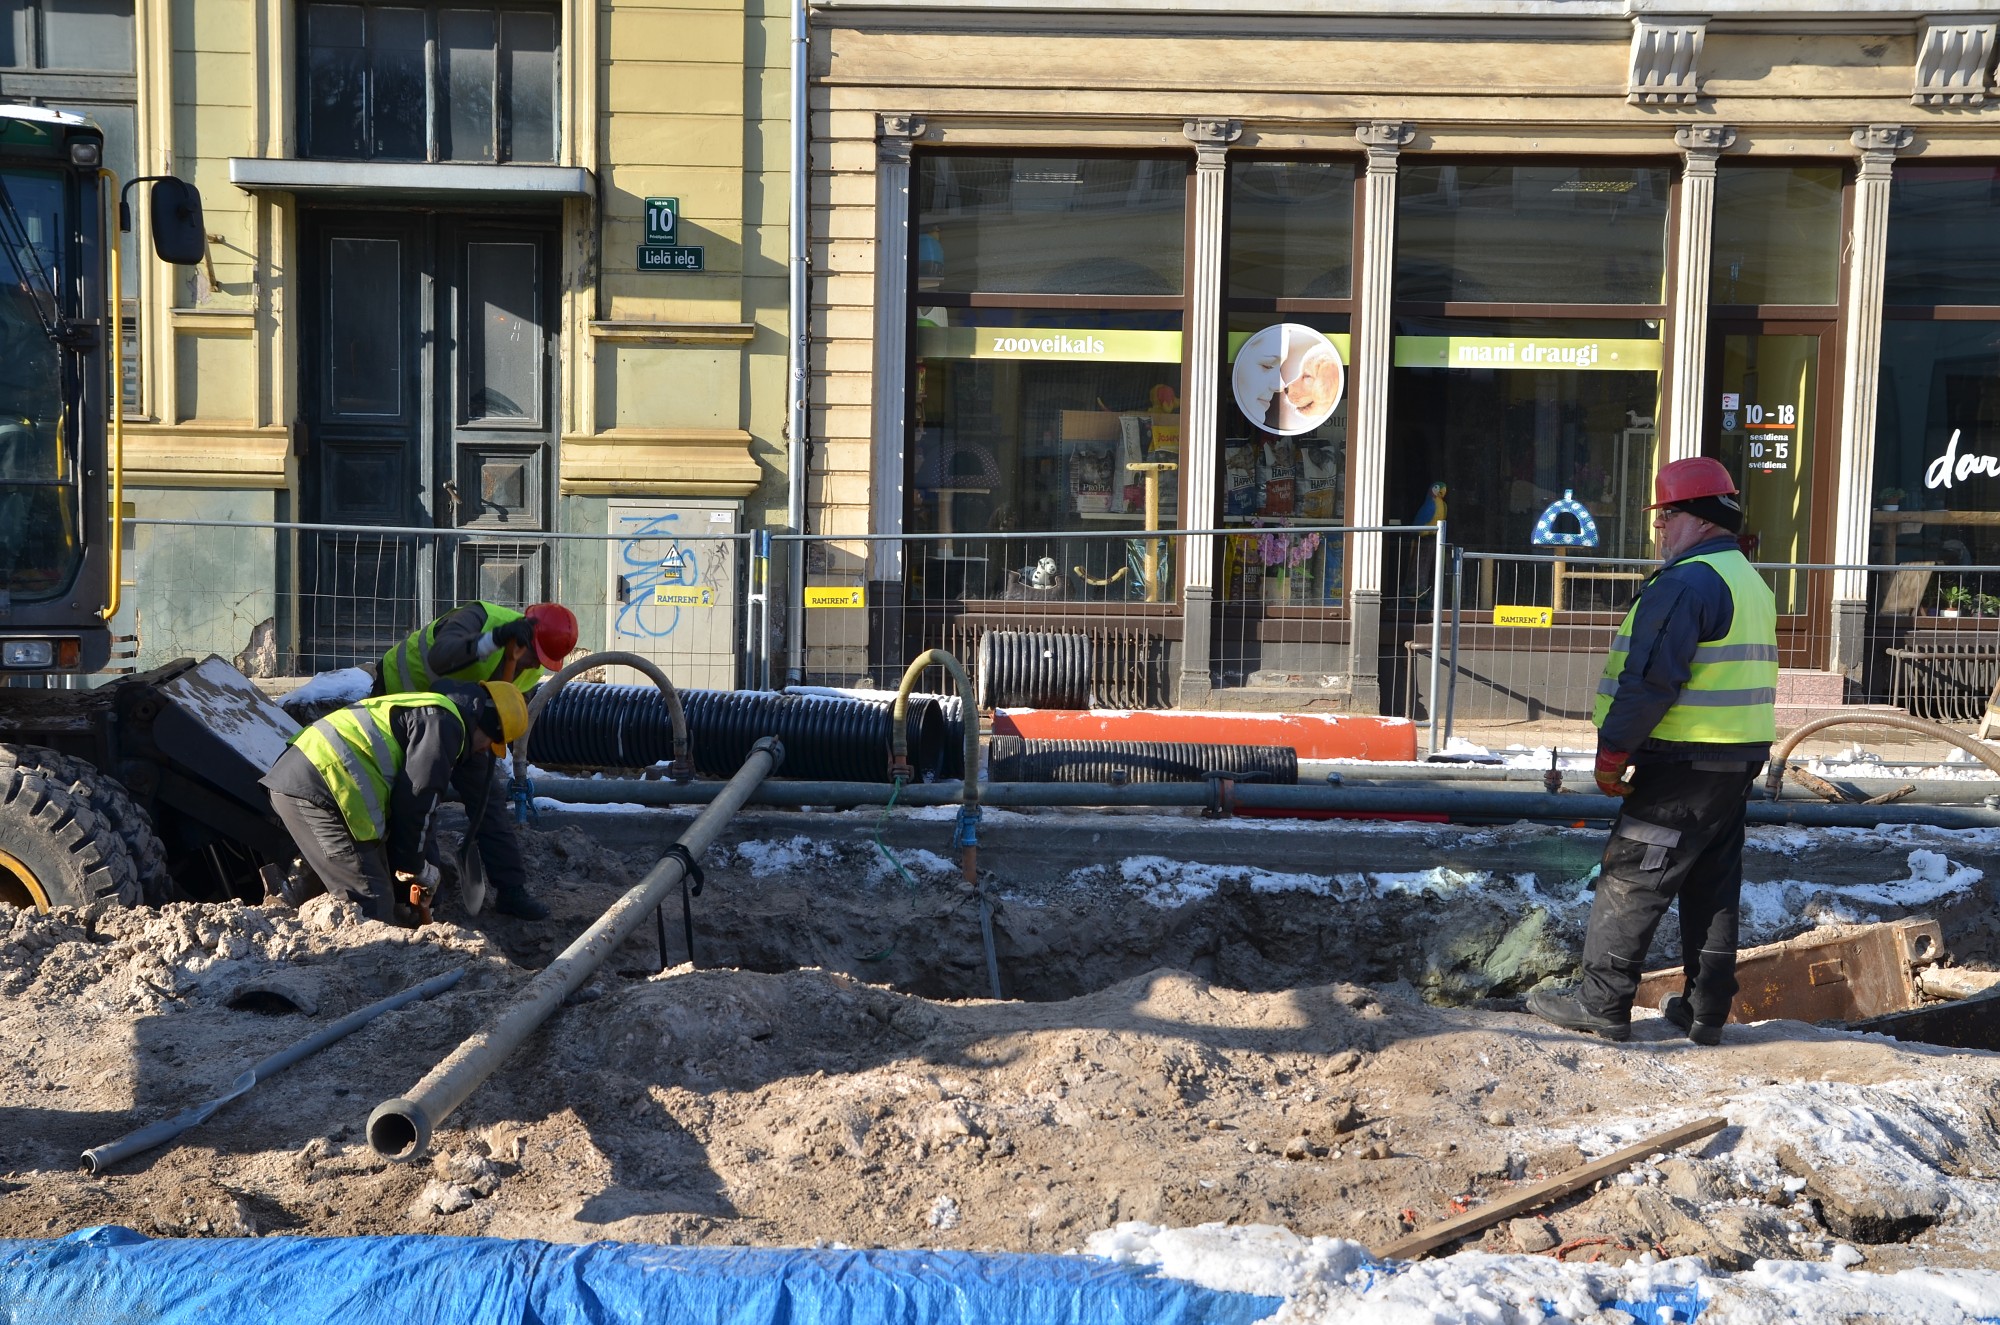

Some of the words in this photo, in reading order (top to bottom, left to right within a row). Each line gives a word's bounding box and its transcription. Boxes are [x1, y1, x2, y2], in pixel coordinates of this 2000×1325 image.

[648, 208, 673, 232] 10
[645, 249, 671, 265] Lielā
[674, 249, 695, 265] iela
[993, 335, 1105, 354] zooveikals
[1458, 343, 1515, 362] mani
[1521, 343, 1598, 367] draugi
[1745, 404, 1763, 424] 10
[1777, 404, 1795, 425] 18
[1749, 442, 1764, 458] 10
[1774, 442, 1789, 459] 15
[656, 594, 699, 604] RAMIRENT
[811, 597, 850, 605] RAMIRENT
[1500, 615, 1538, 624] RAMIRENT
